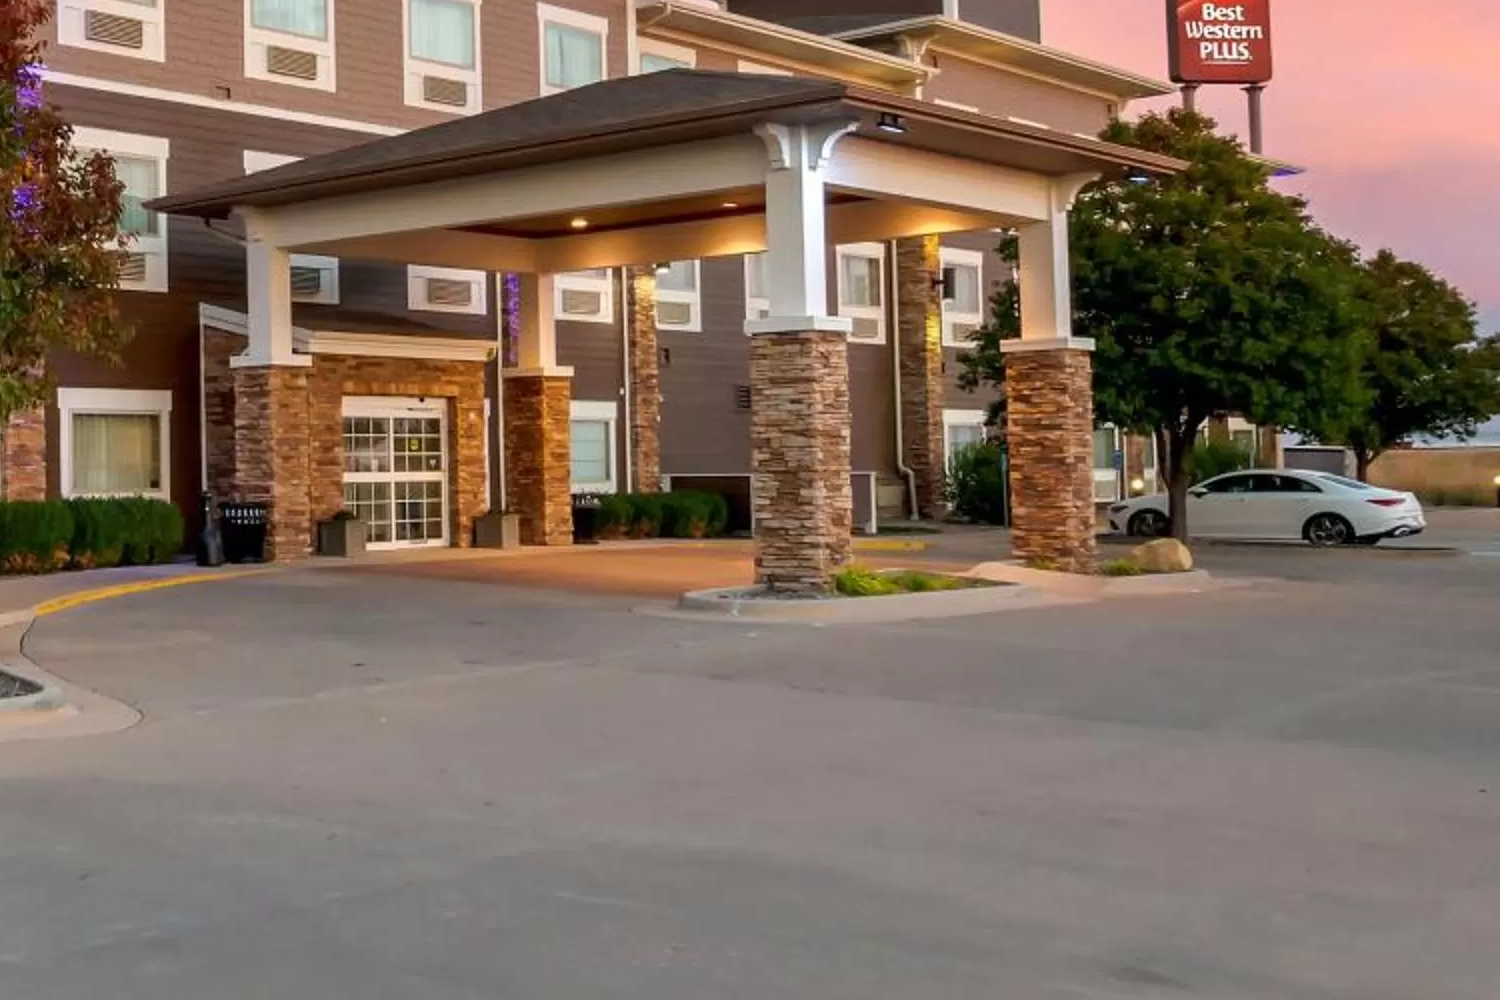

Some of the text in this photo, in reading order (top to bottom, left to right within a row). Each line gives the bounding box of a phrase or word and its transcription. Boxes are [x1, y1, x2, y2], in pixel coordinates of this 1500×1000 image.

[1202, 3, 1245, 21] Best
[1185, 21, 1263, 39] Western
[1200, 42, 1250, 60] PLUS
